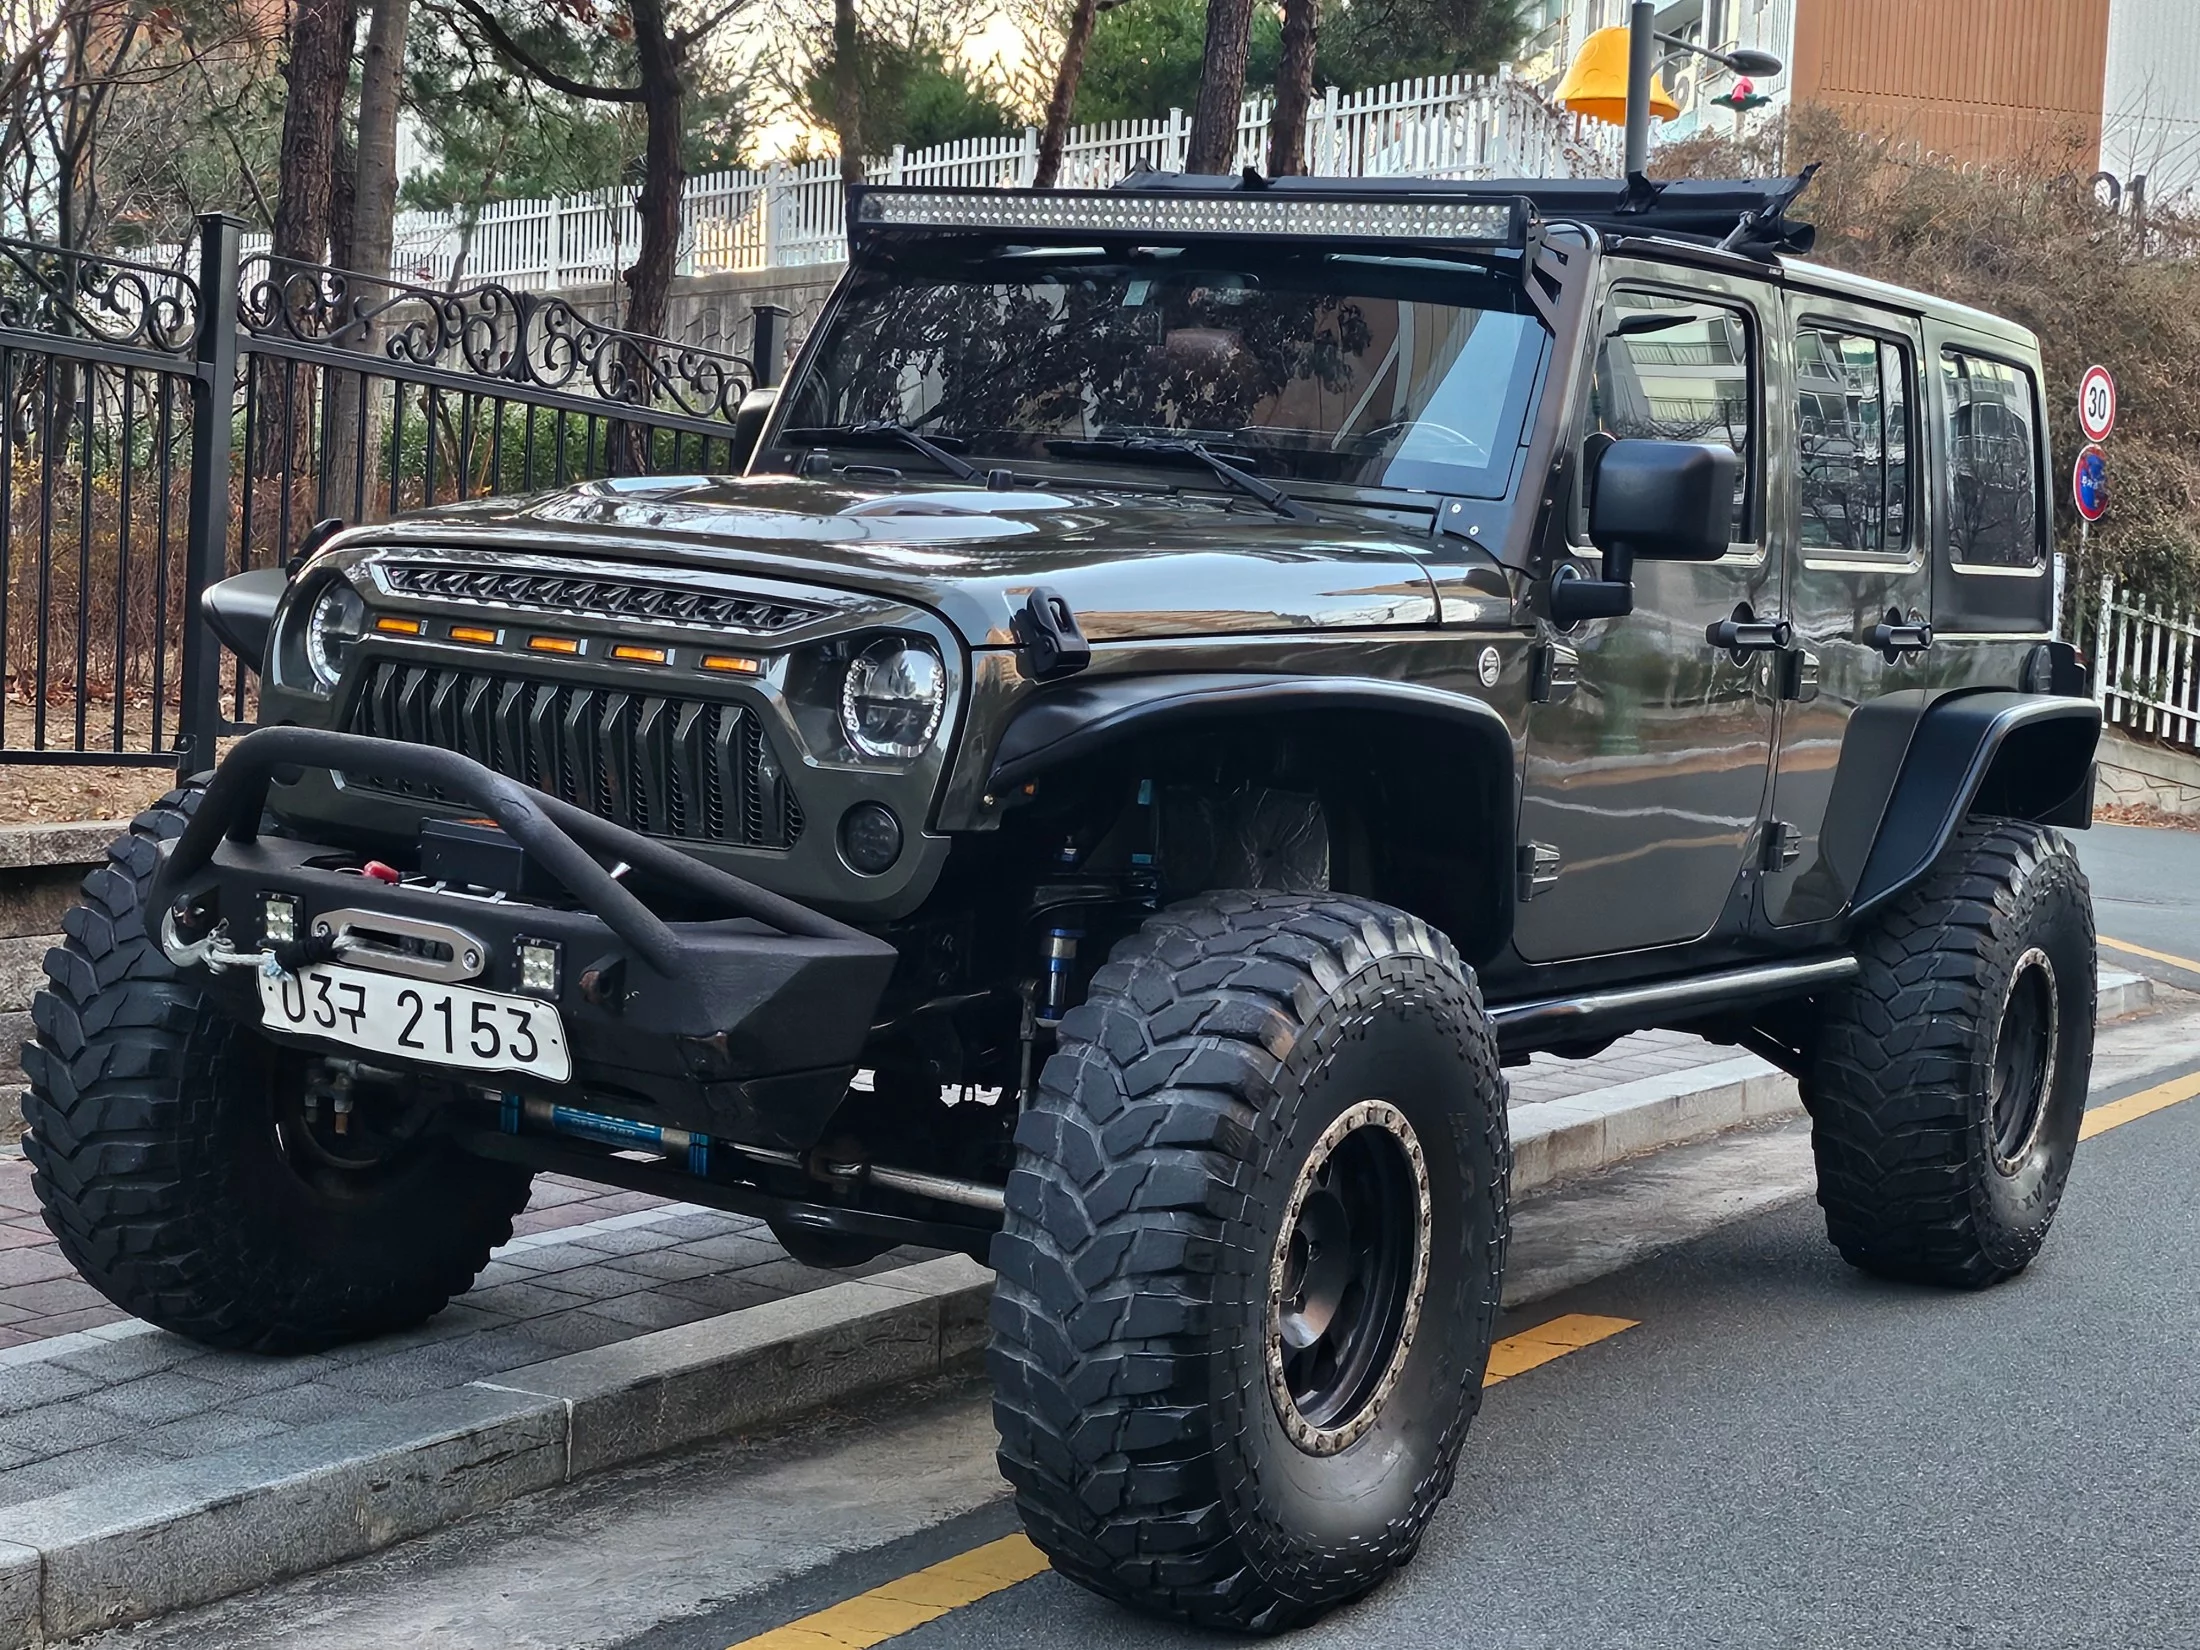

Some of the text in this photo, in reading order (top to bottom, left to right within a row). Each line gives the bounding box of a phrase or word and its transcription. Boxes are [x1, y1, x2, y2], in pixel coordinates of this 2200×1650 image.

[2088, 386, 2106, 420] 30
[281, 972, 539, 1063] 03구 2153
